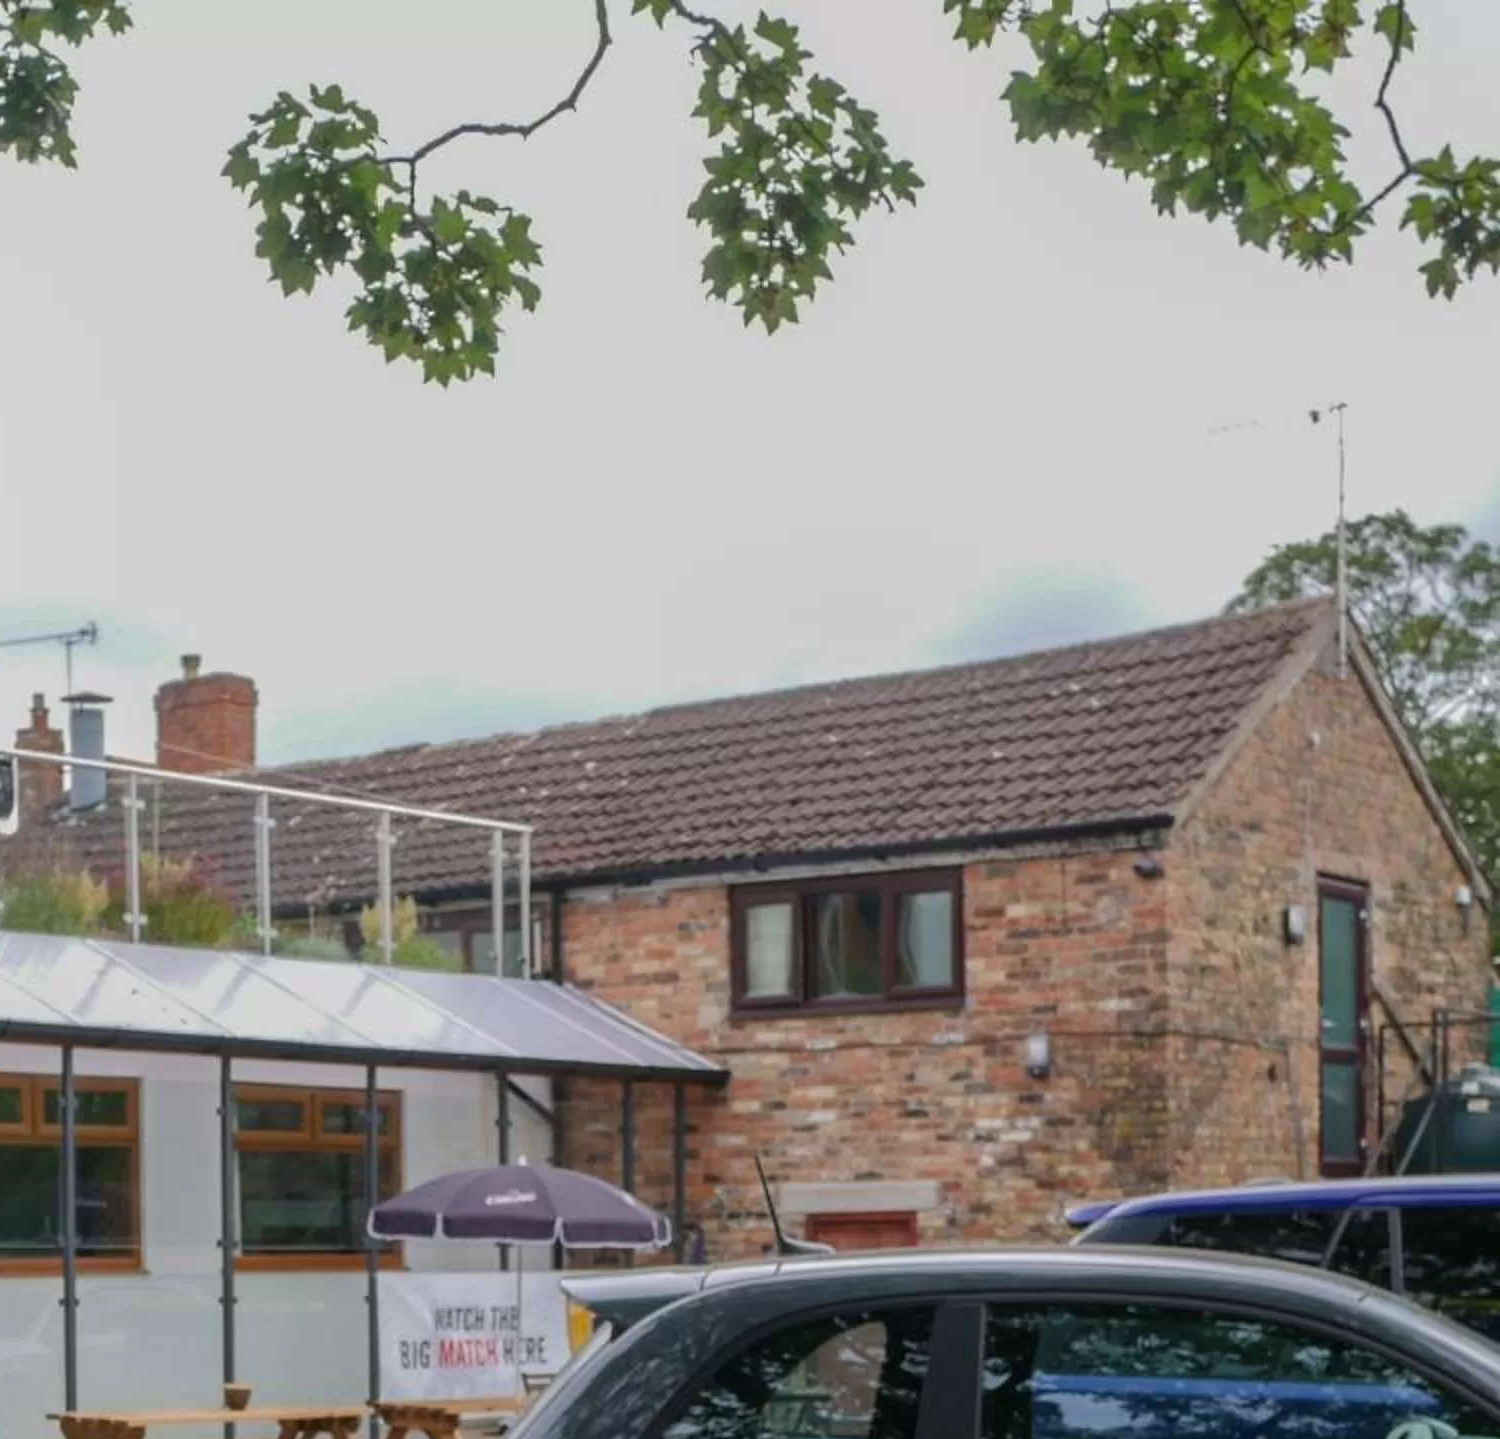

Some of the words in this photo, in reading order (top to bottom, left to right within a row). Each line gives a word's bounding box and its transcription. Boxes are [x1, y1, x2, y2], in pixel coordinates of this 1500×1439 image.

[490, 1305, 520, 1332] THE
[400, 1340, 431, 1369] BIG
[439, 1339, 498, 1369] MATCH
